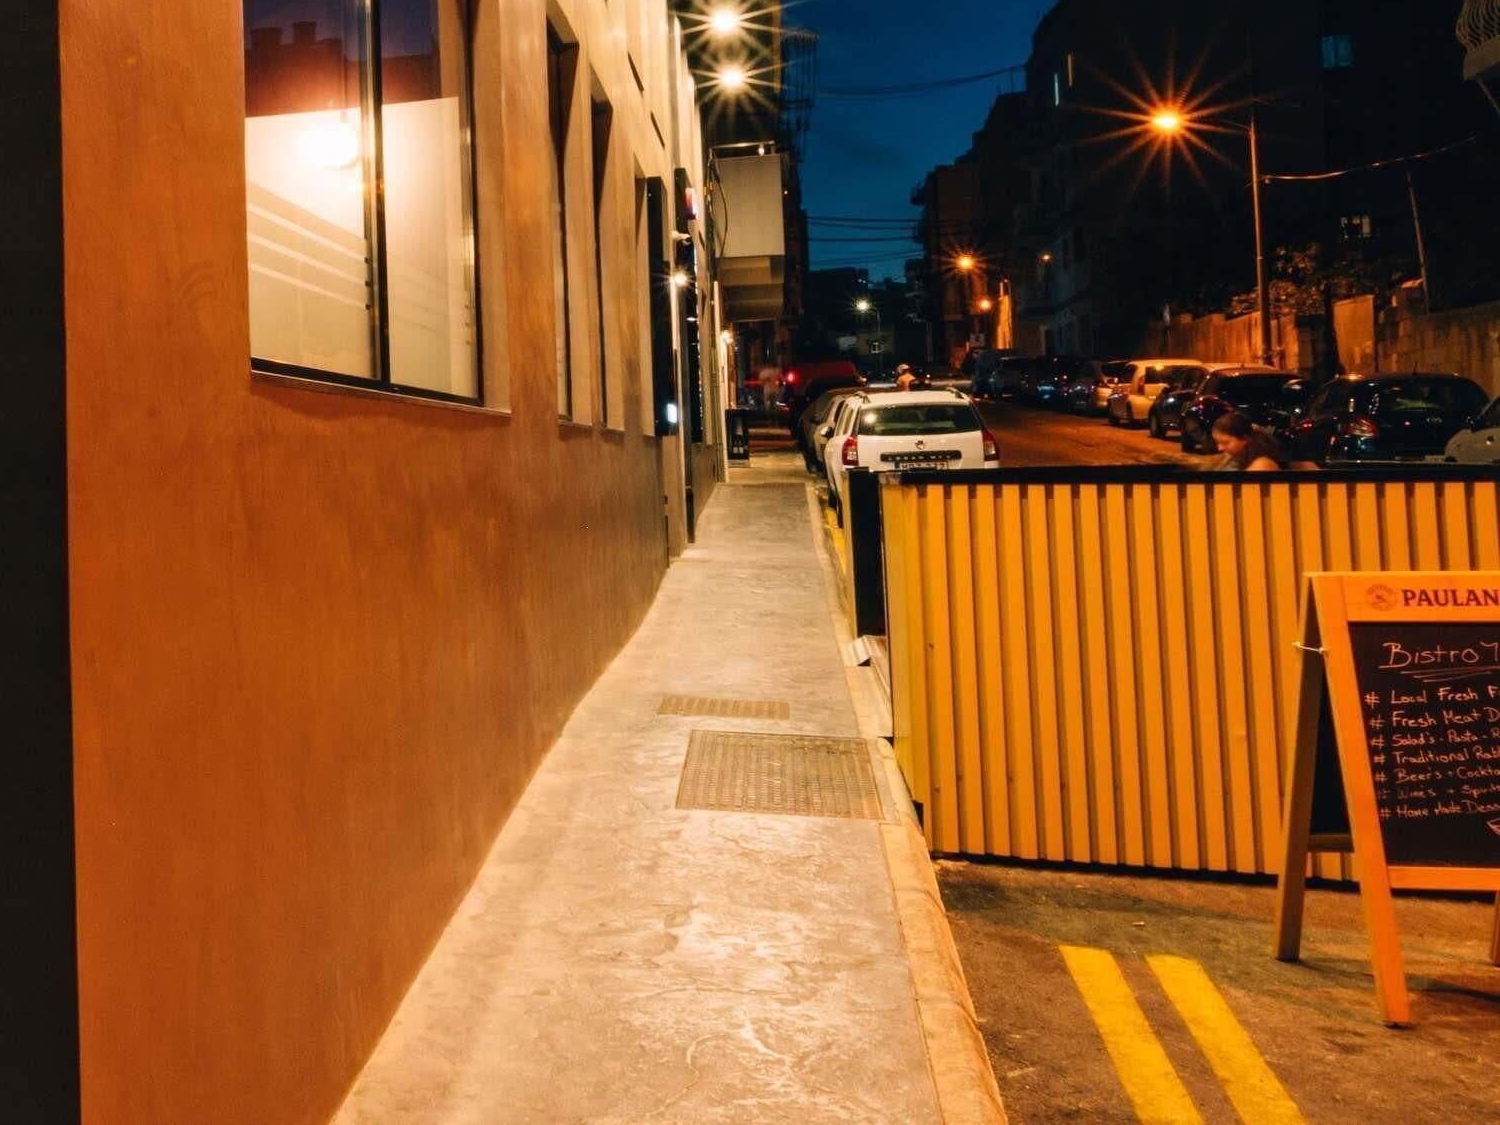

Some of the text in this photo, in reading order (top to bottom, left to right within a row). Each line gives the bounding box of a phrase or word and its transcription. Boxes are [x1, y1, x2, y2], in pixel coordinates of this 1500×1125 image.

[1402, 588, 1500, 607] PAULAN
[1379, 642, 1479, 669] Bistro
[1391, 689, 1428, 705] Local
[1438, 686, 1479, 702] Fresh
[1488, 685, 1500, 699] F
[1392, 711, 1437, 728] Fresh
[1443, 708, 1480, 725] Meat
[1447, 729, 1479, 743] Pasta
[1392, 747, 1470, 764] Traditional
[1396, 803, 1429, 818] Home
